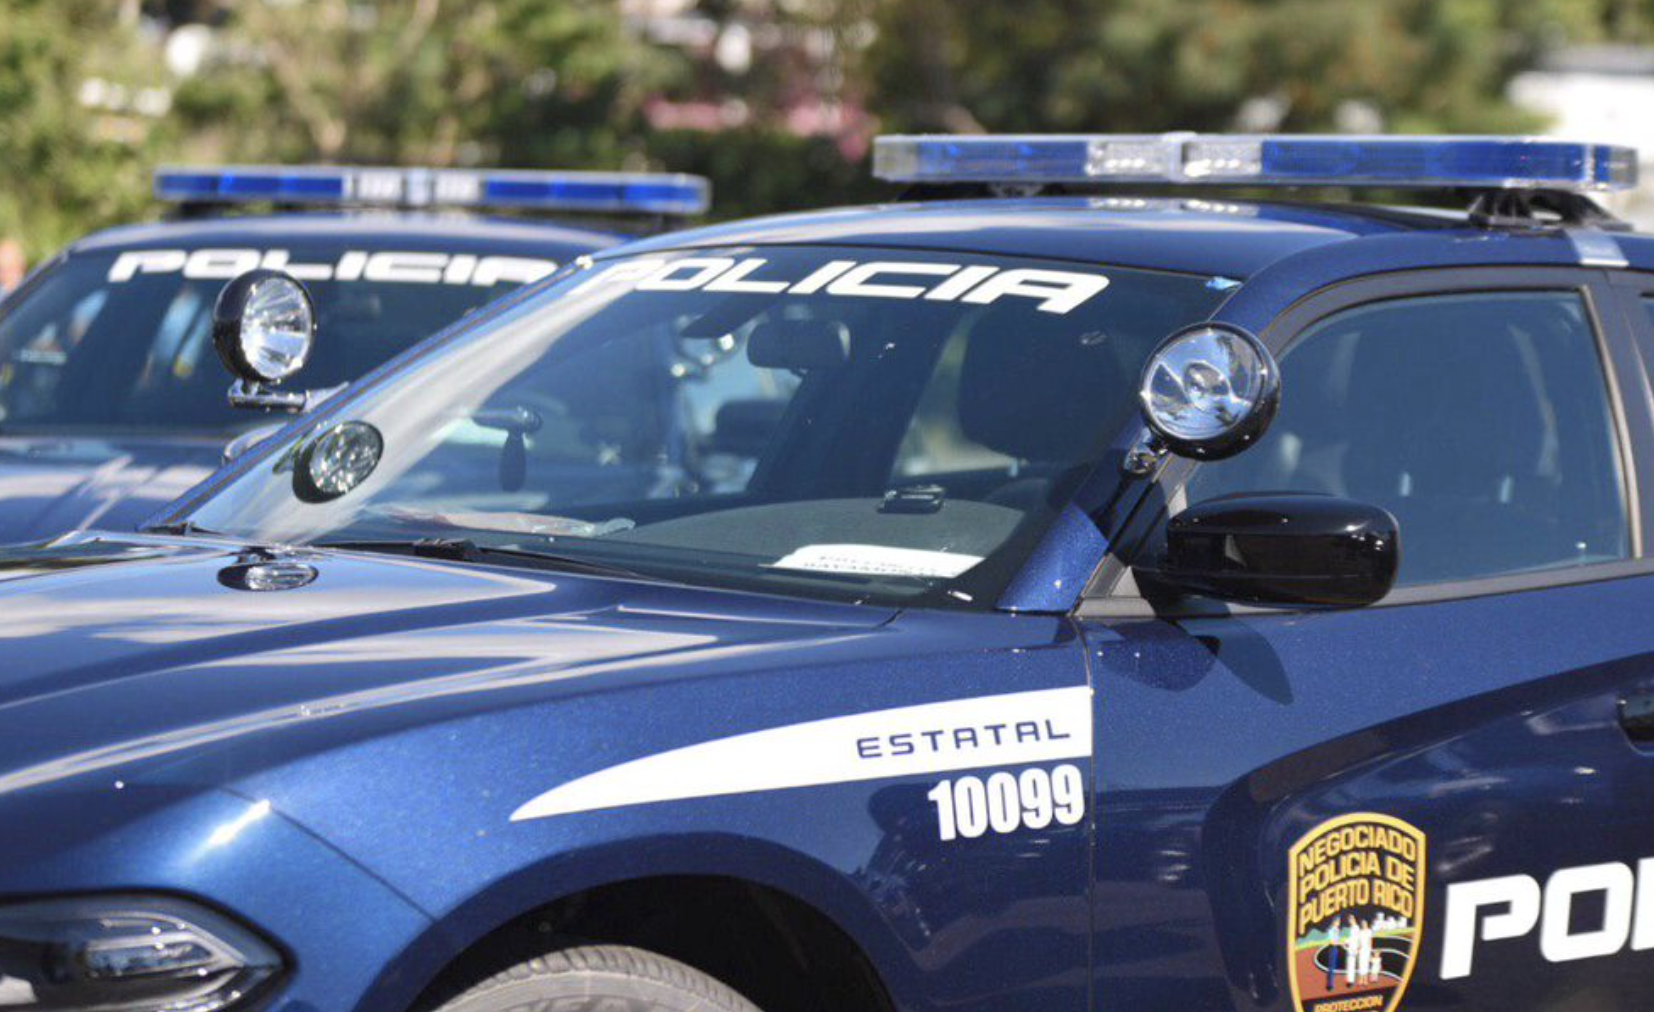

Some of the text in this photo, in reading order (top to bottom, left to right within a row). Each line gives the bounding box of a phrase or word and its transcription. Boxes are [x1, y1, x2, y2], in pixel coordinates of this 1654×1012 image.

[108, 249, 560, 286] POLICIA
[567, 257, 1111, 315] POLICIA
[856, 719, 1071, 759] ESTATAL
[927, 764, 1086, 842] 10099
[1299, 824, 1417, 877] NEGOCIADO
[1300, 851, 1416, 904] POLICIA DE
[1299, 877, 1414, 935] PUERTO RICO
